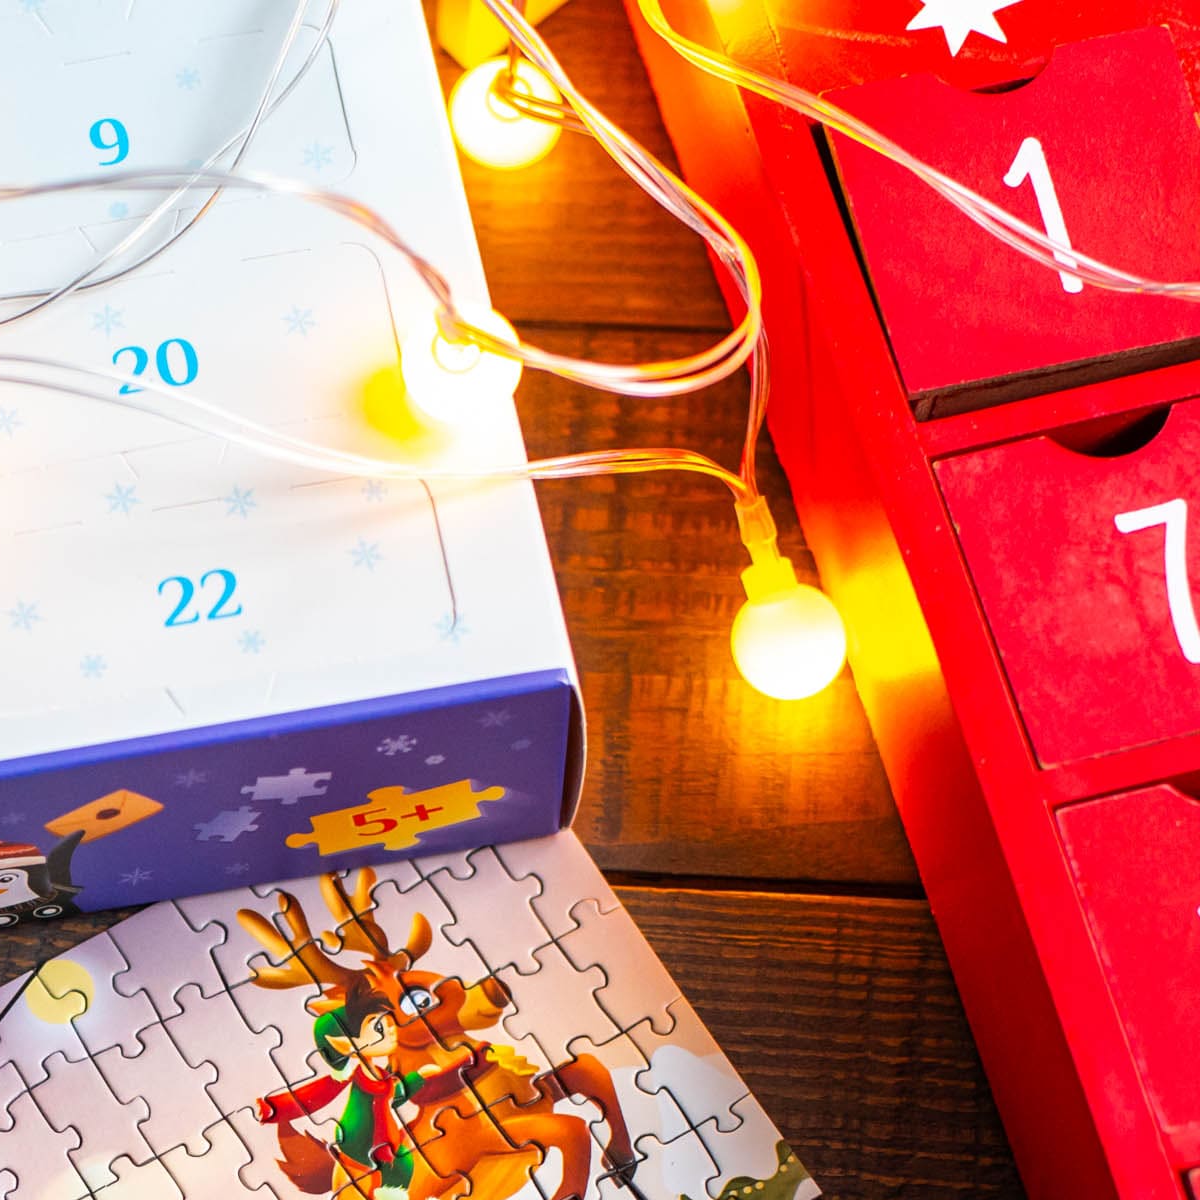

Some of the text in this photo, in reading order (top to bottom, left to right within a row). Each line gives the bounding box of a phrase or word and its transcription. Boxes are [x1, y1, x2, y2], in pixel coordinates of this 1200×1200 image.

[88, 117, 130, 165] 9
[1003, 137, 1084, 293] 1
[111, 338, 199, 395] 20
[157, 568, 243, 628] 22
[1114, 498, 1200, 663] 7
[352, 804, 443, 836] 5+
